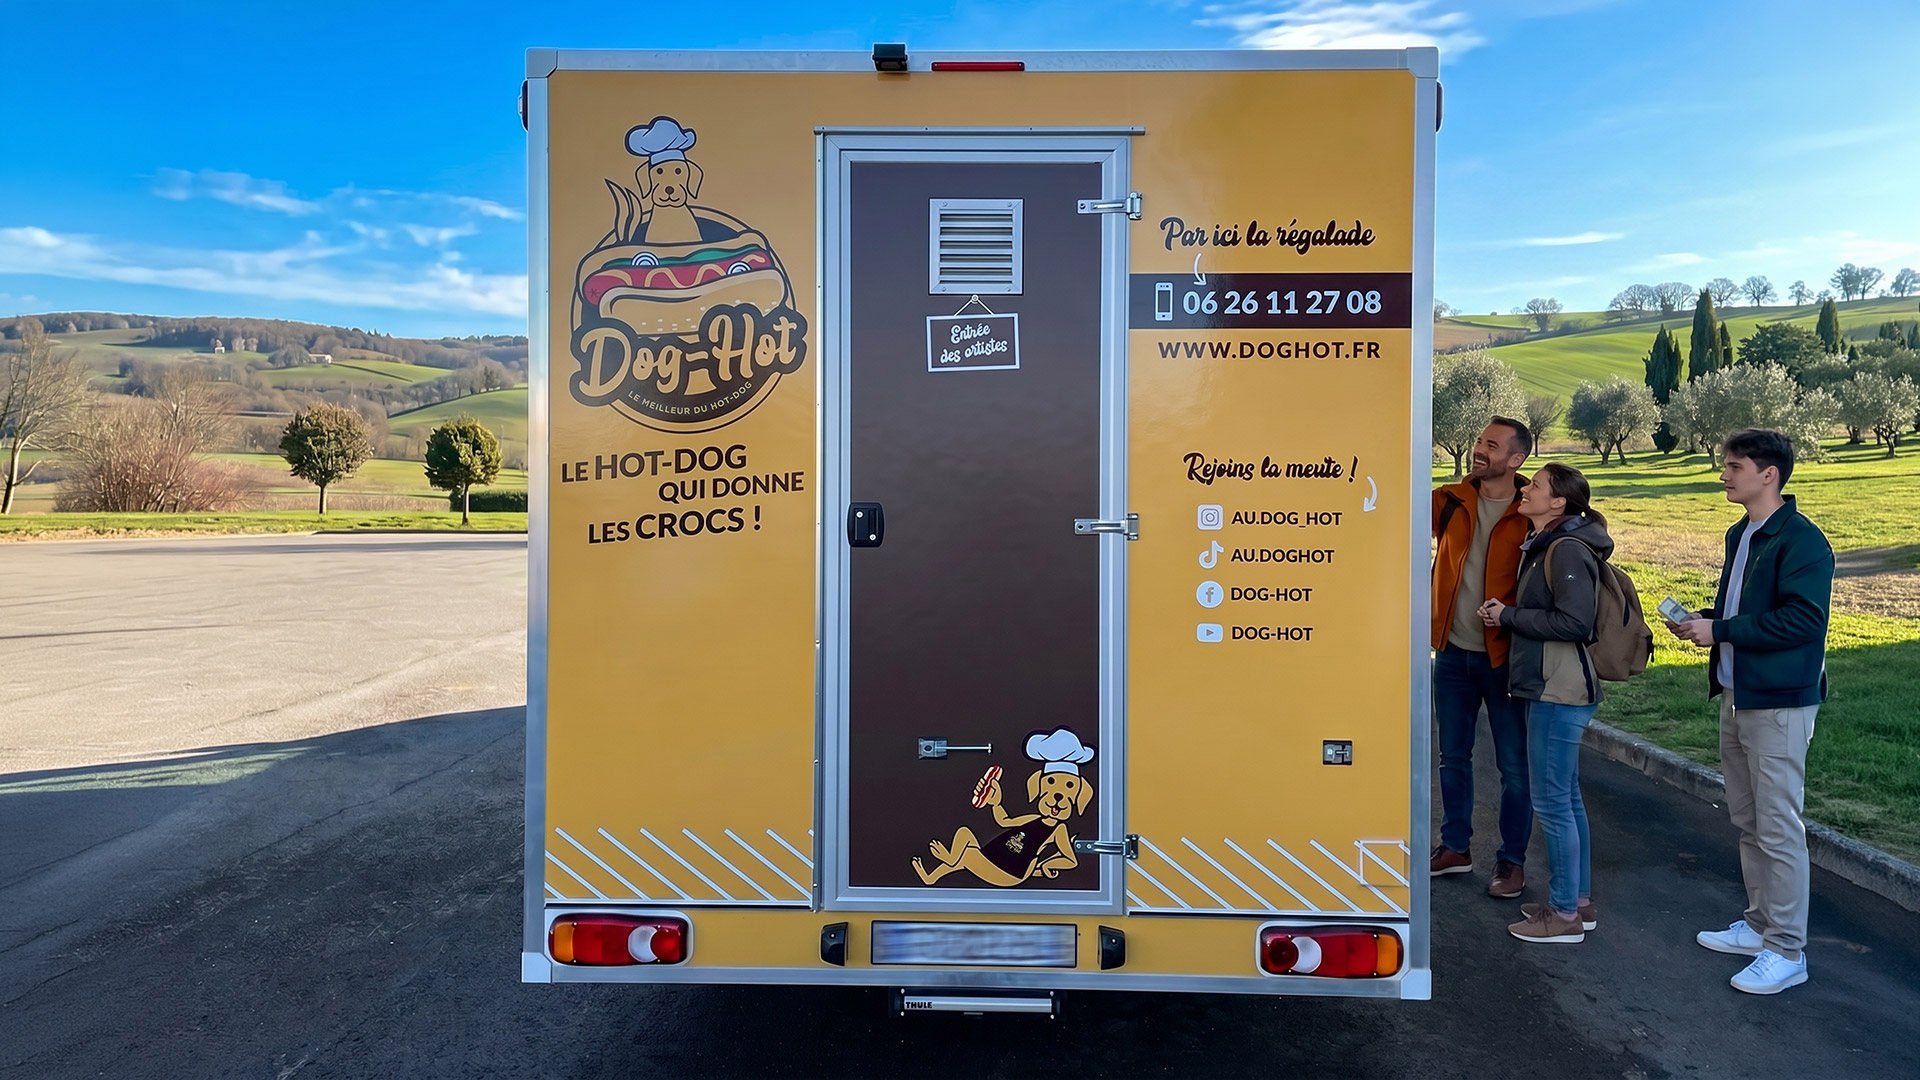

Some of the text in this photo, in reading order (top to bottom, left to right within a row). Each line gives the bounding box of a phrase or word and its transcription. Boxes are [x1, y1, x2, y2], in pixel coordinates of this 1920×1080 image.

[1159, 217, 1376, 254] Par ici la régalade
[1183, 290, 1381, 314] 06 26 11 27 08
[950, 323, 991, 343] Entrée
[579, 314, 797, 396] Dog-Hot
[940, 338, 1008, 363] des artistes
[1158, 342, 1381, 358] WWW.DOGHOT.FR
[628, 381, 753, 415] LE MEILLEUR DU HOT-DOG
[561, 444, 747, 483] LE HOT-DOG
[1183, 452, 1359, 485] Rejoins la meute !
[658, 471, 805, 504] QUI DONNE
[588, 505, 762, 544] LES CROCS !
[1231, 511, 1343, 528] AU.DOG_HOT
[1231, 548, 1335, 563] AU.DOGHOT
[1230, 587, 1313, 602] DOG-HOT
[1231, 626, 1314, 641] DOG-HOT
[905, 1001, 933, 1009] THULE
